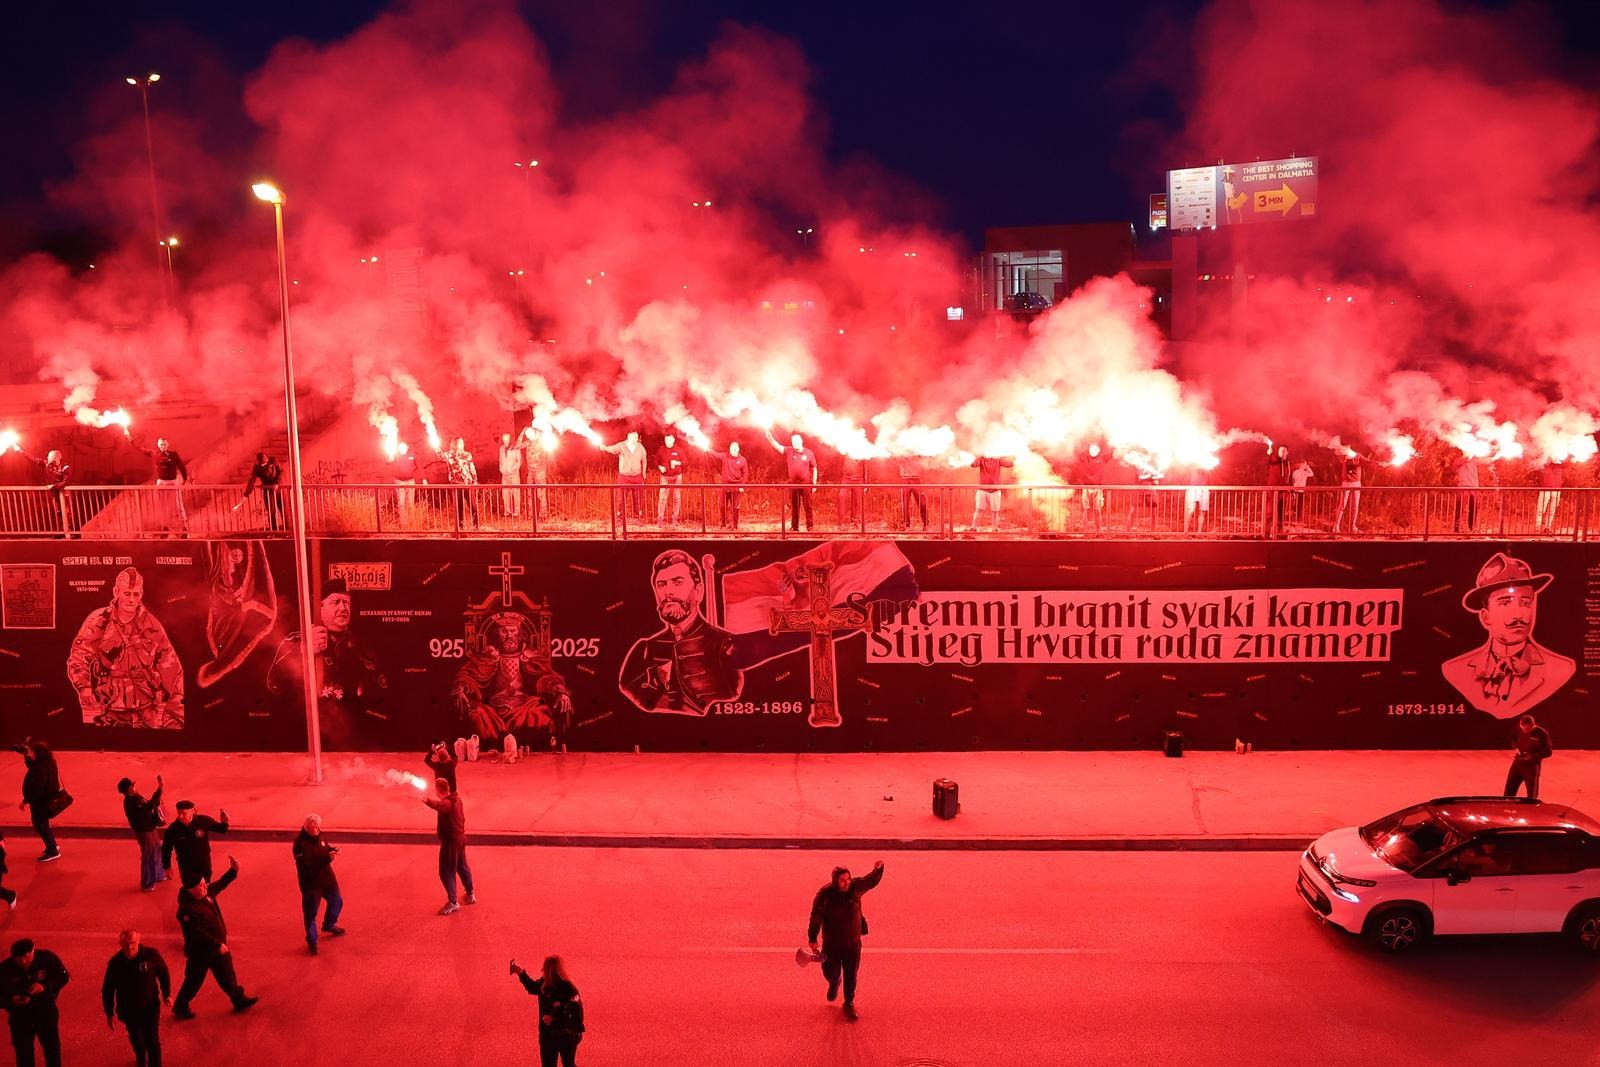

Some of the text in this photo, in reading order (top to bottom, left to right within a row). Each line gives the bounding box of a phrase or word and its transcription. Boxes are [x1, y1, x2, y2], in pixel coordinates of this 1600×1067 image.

[1257, 165, 1275, 173] BEST
[1276, 161, 1313, 171] SHOPPING
[1242, 174, 1267, 182] CENTER
[1258, 195, 1283, 207] 3 MIN
[156, 556, 178, 565] BROJ
[846, 592, 1401, 633] Spremni branit svaki kamen
[429, 638, 465, 658] 925
[550, 638, 601, 658] 2025
[871, 626, 1388, 666] Stijeg Hrvata roda znamen
[714, 701, 803, 715] 1823-1896
[1387, 703, 1465, 715] 1873-1914
